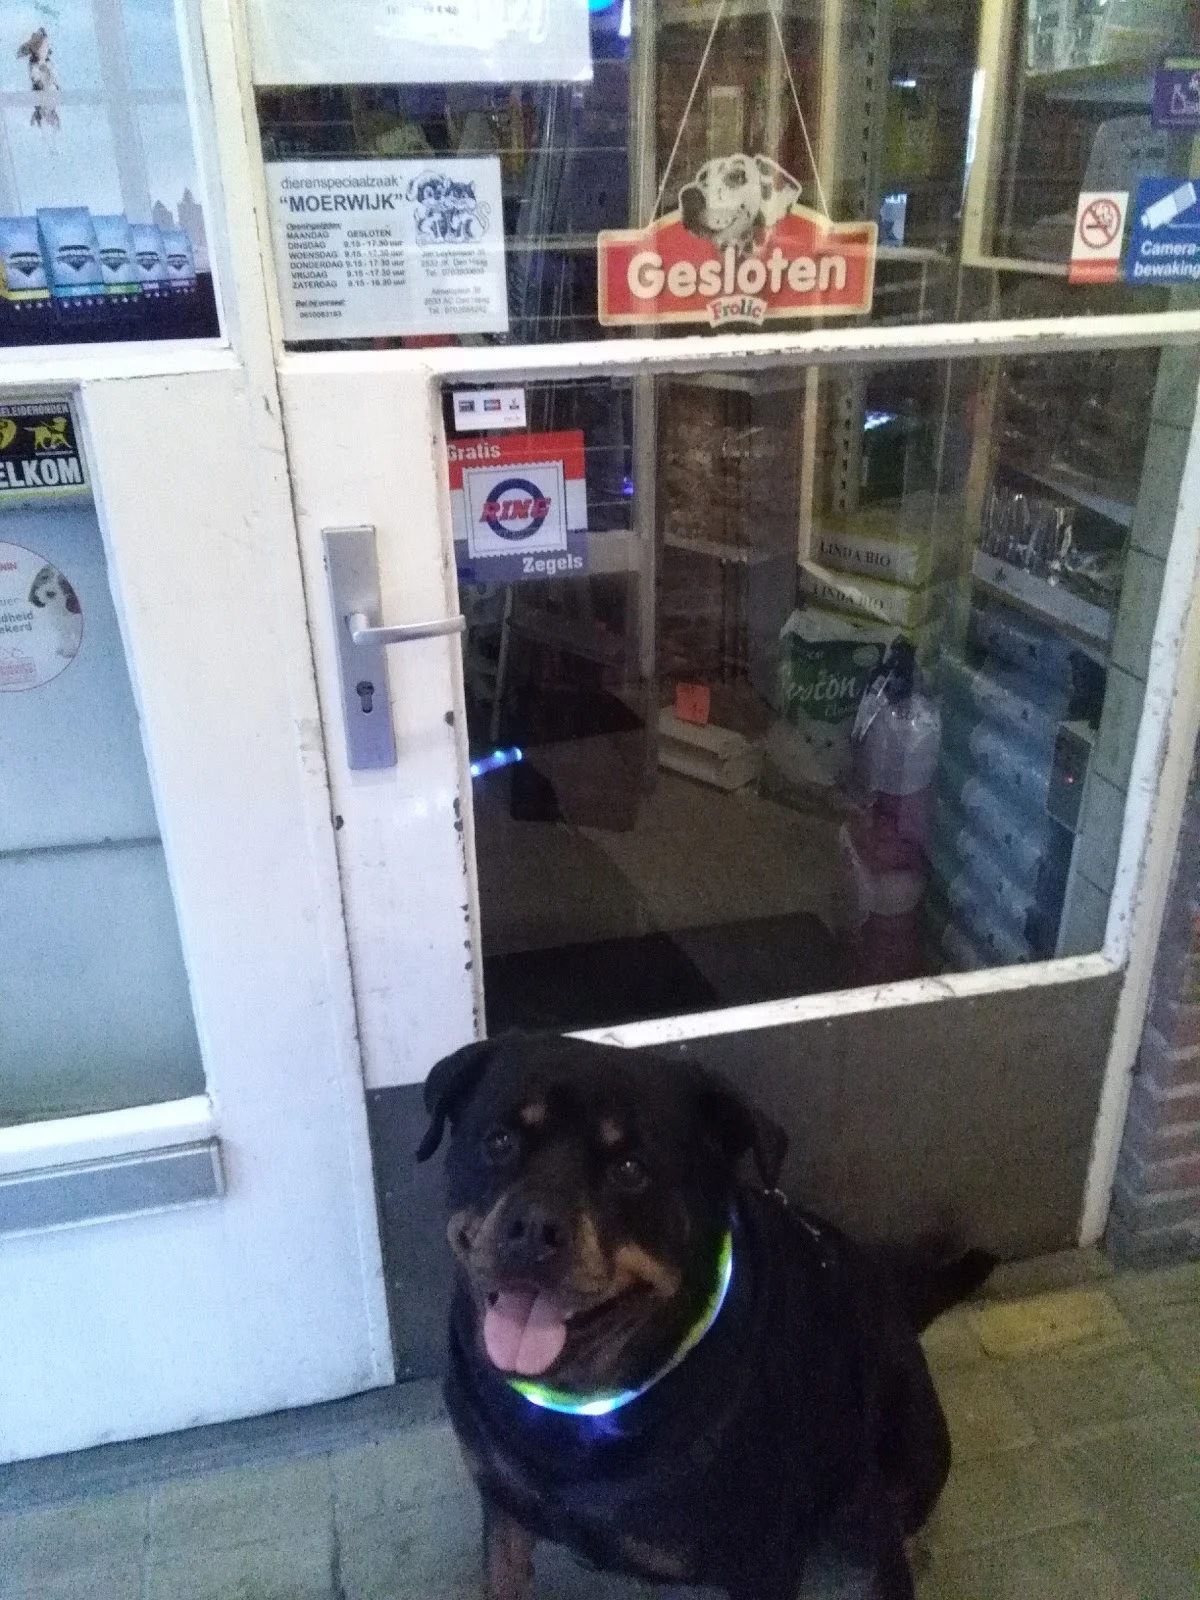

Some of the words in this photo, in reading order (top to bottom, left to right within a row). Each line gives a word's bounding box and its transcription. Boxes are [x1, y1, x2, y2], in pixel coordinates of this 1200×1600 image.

[286, 231, 330, 240] MAANDAG
[347, 229, 392, 238] GESLOTEN
[287, 241, 326, 250] DINSDAG
[289, 250, 338, 260] WOENSDAG
[290, 260, 343, 270] DONDERDAG
[291, 270, 328, 280] VRIJDAG
[627, 246, 847, 300] Gesloten
[292, 280, 338, 290] ZATERDAG
[711, 298, 763, 322] Frolic
[447, 442, 501, 461] Gratis
[820, 541, 861, 562] LINDA
[865, 549, 891, 567] BIO
[522, 553, 583, 575] Zegels
